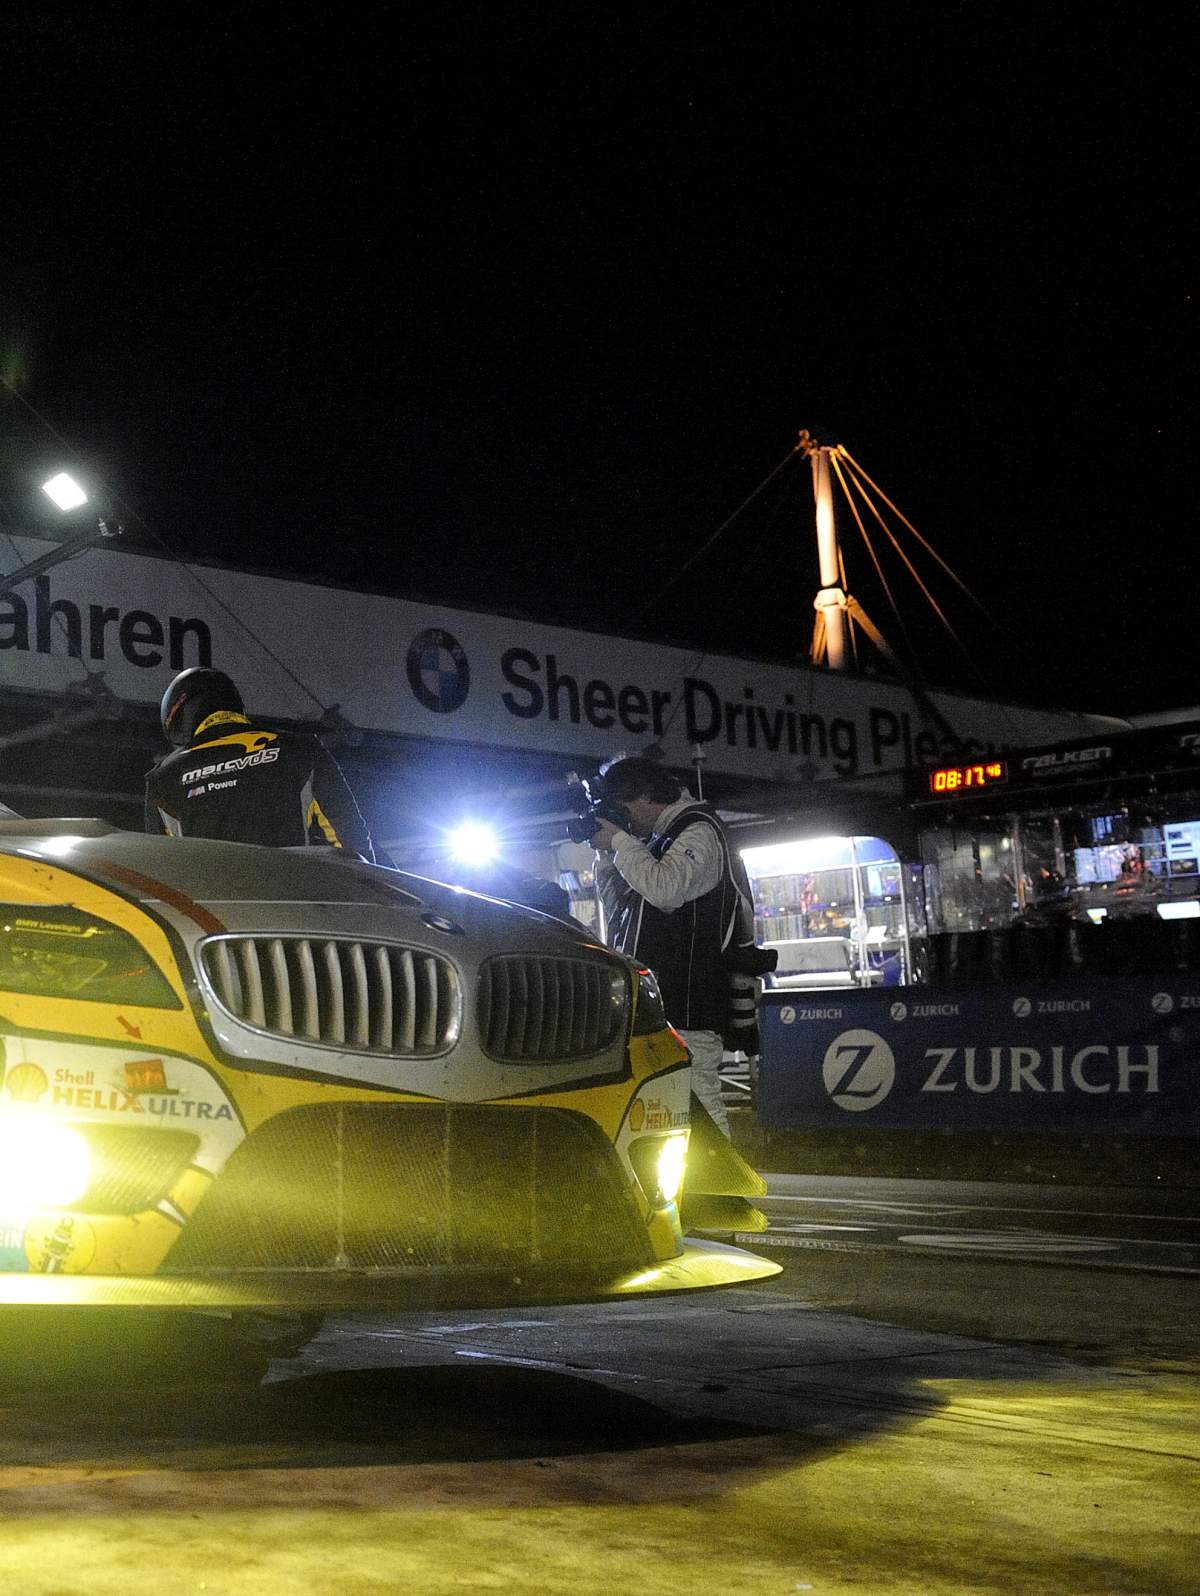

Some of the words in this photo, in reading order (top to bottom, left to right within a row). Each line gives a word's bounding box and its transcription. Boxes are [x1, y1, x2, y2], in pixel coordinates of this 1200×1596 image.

[501, 647, 671, 736] Sheer
[684, 677, 858, 776] Driving
[207, 779, 238, 792] Power
[912, 1004, 960, 1017] ZURICH
[1038, 1000, 1091, 1013] ZURICH
[800, 1008, 843, 1021] ZURICH
[921, 1044, 1161, 1095] ZURICH
[55, 1069, 94, 1086] Shell
[53, 1084, 145, 1114] HELIX
[150, 1097, 233, 1121] ULTRA
